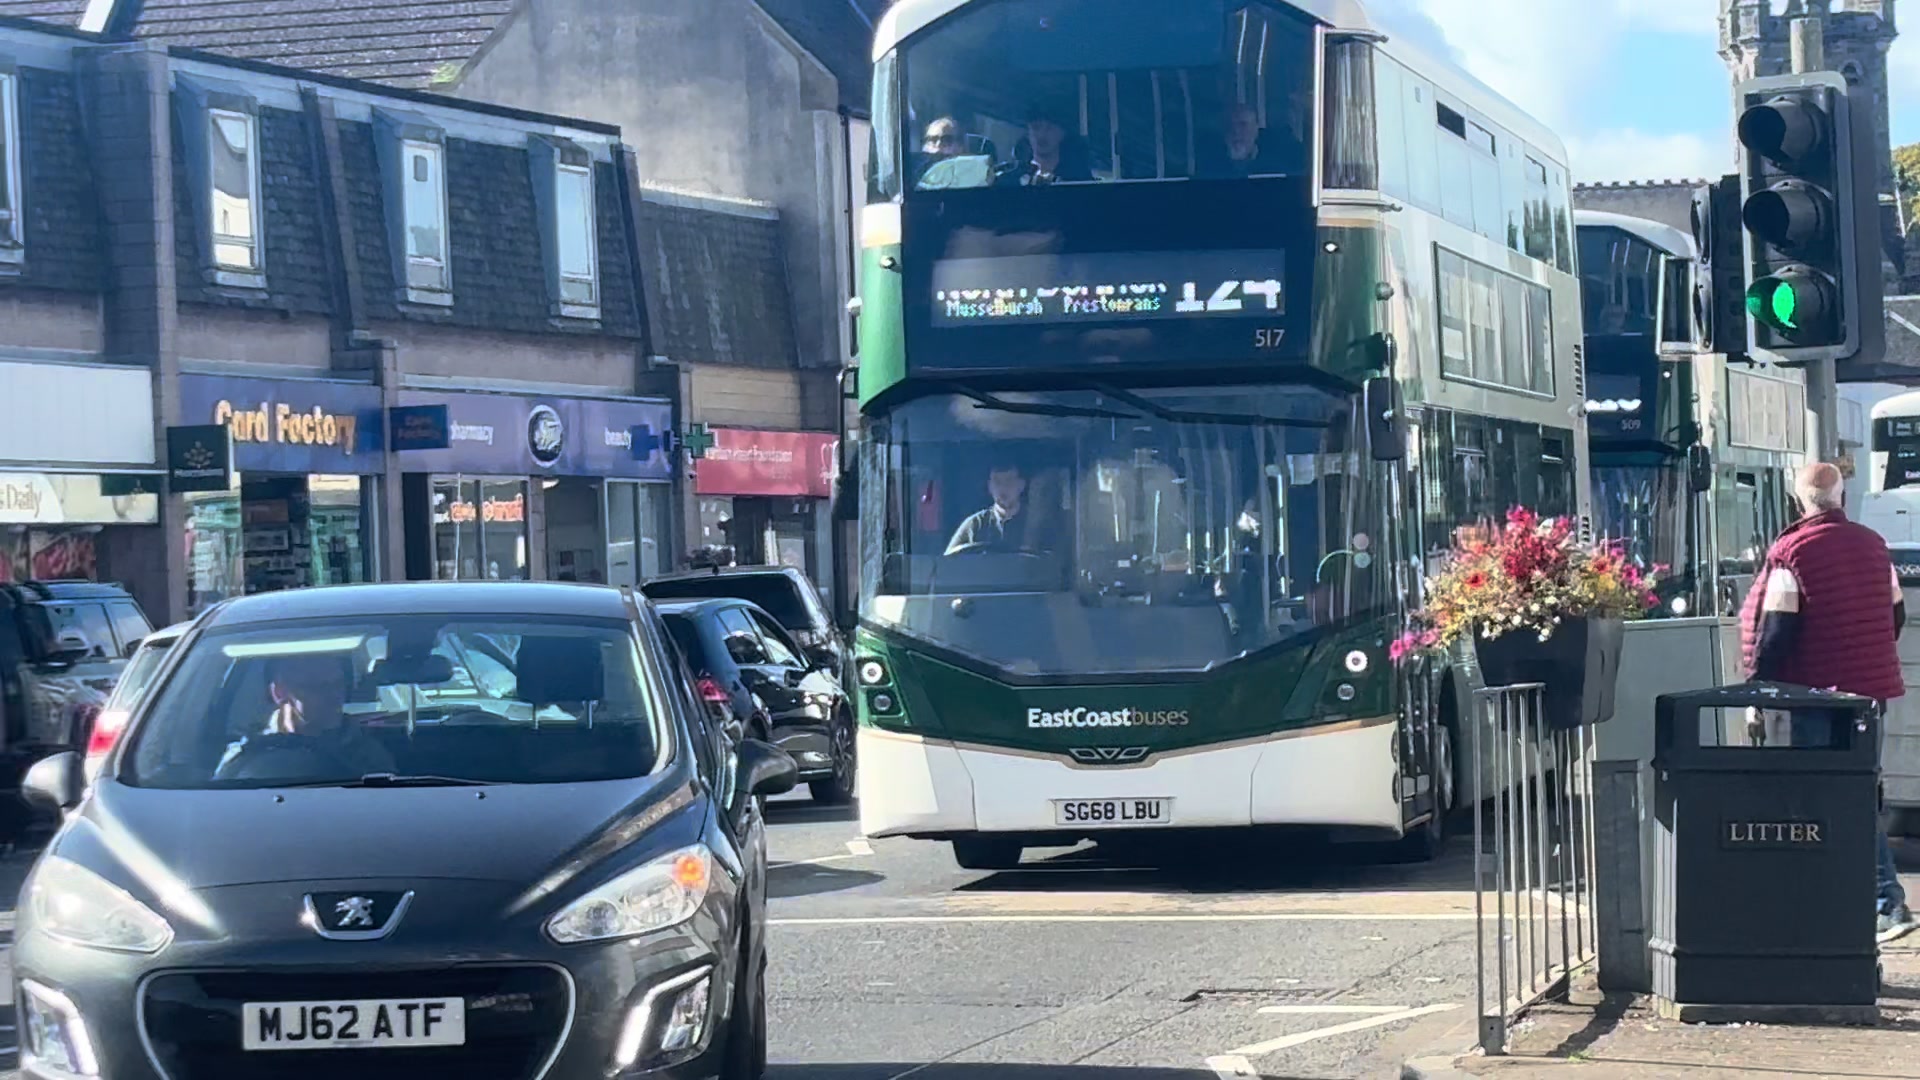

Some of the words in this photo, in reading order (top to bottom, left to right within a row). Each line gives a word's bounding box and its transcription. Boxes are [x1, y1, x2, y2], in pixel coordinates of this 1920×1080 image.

[1255, 328, 1285, 347] 517
[215, 399, 269, 442] Card
[276, 402, 356, 455] Factory
[6, 481, 42, 518] Daily
[1027, 707, 1190, 728] EastCoastbuses
[1064, 803, 1115, 821] SG68
[1121, 801, 1160, 819] LBU
[1730, 822, 1821, 842] LITTER
[259, 1004, 360, 1042] MJ62
[373, 1002, 446, 1040] ATF
